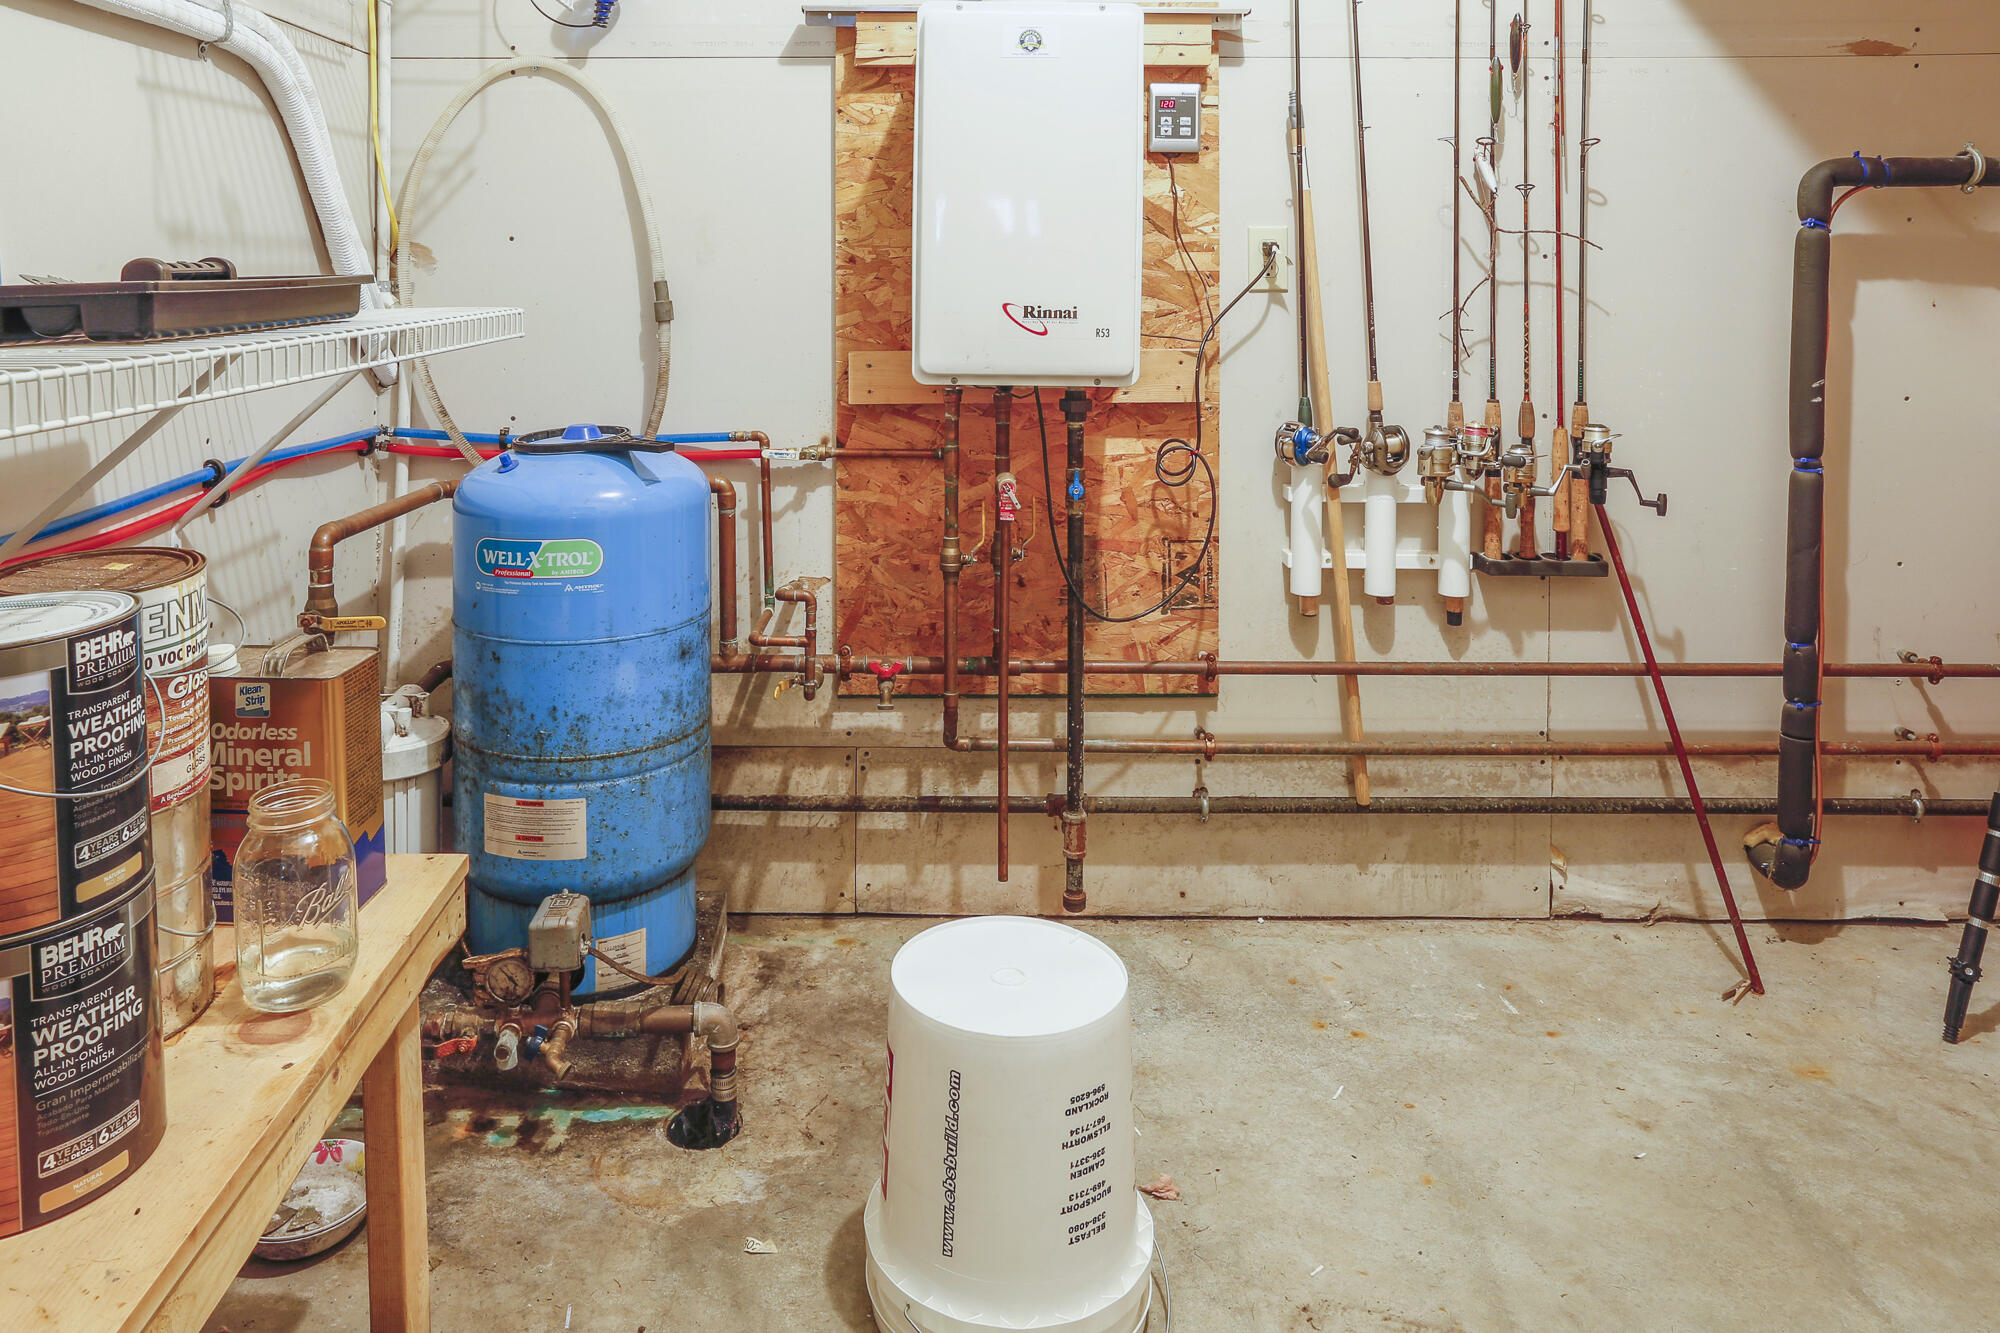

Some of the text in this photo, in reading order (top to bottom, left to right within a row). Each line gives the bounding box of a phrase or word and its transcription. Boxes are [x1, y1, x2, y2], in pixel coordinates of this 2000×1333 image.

[1160, 100, 1175, 108] 120
[1022, 305, 1078, 319] Rinnai
[1095, 328, 1110, 338] R53
[494, 569, 532, 577] Professional
[75, 629, 123, 665] BEHR
[158, 648, 184, 667] VOC
[76, 643, 136, 679] PREMIUM
[67, 690, 130, 720] TRANSPARENT
[245, 695, 265, 706] Strip
[67, 694, 142, 739] WEATHER
[70, 709, 146, 759] PROOFING
[211, 722, 298, 741] Odorless
[70, 742, 125, 771] ALL-IN-ONE
[70, 750, 132, 782] WOOD FINISH
[210, 741, 311, 767] Mineral
[78, 832, 119, 860] 4 YEARS
[122, 826, 129, 841] 6
[40, 926, 103, 970] BEHR
[41, 935, 126, 984] PREMIUM
[42, 977, 75, 993] WOOD
[30, 986, 114, 1028] TRANSPARENT
[31, 985, 136, 1047] WEATHER
[33, 997, 144, 1068] PROOFING
[33, 1042, 104, 1080] ALL-IN-ONE
[34, 1047, 115, 1091] WOOD FINISH
[35, 1095, 67, 1111] Gran
[1065, 1091, 1109, 1117] ROCKLAND
[1070, 1083, 1105, 1105] 596-6205
[98, 1128, 109, 1145] 6
[109, 1106, 138, 1132] YEARS
[1061, 1121, 1111, 1150] ELLSWORTH
[1069, 1115, 1106, 1137] 667-7134
[42, 1135, 94, 1170] 4 YEARS
[57, 1144, 95, 1166] ON DECKS
[942, 1069, 961, 1258] www.ebsbuild.com
[1070, 1146, 1106, 1170] 236-3371
[73, 1170, 104, 1190] NATURAL
[1070, 1158, 1105, 1181] CAMDEN
[1060, 1185, 1112, 1216] BUCKSPORT
[1068, 1180, 1106, 1202] 469-7313
[1068, 1211, 1106, 1235] 338-4080
[1068, 1221, 1106, 1246] BELFAST
